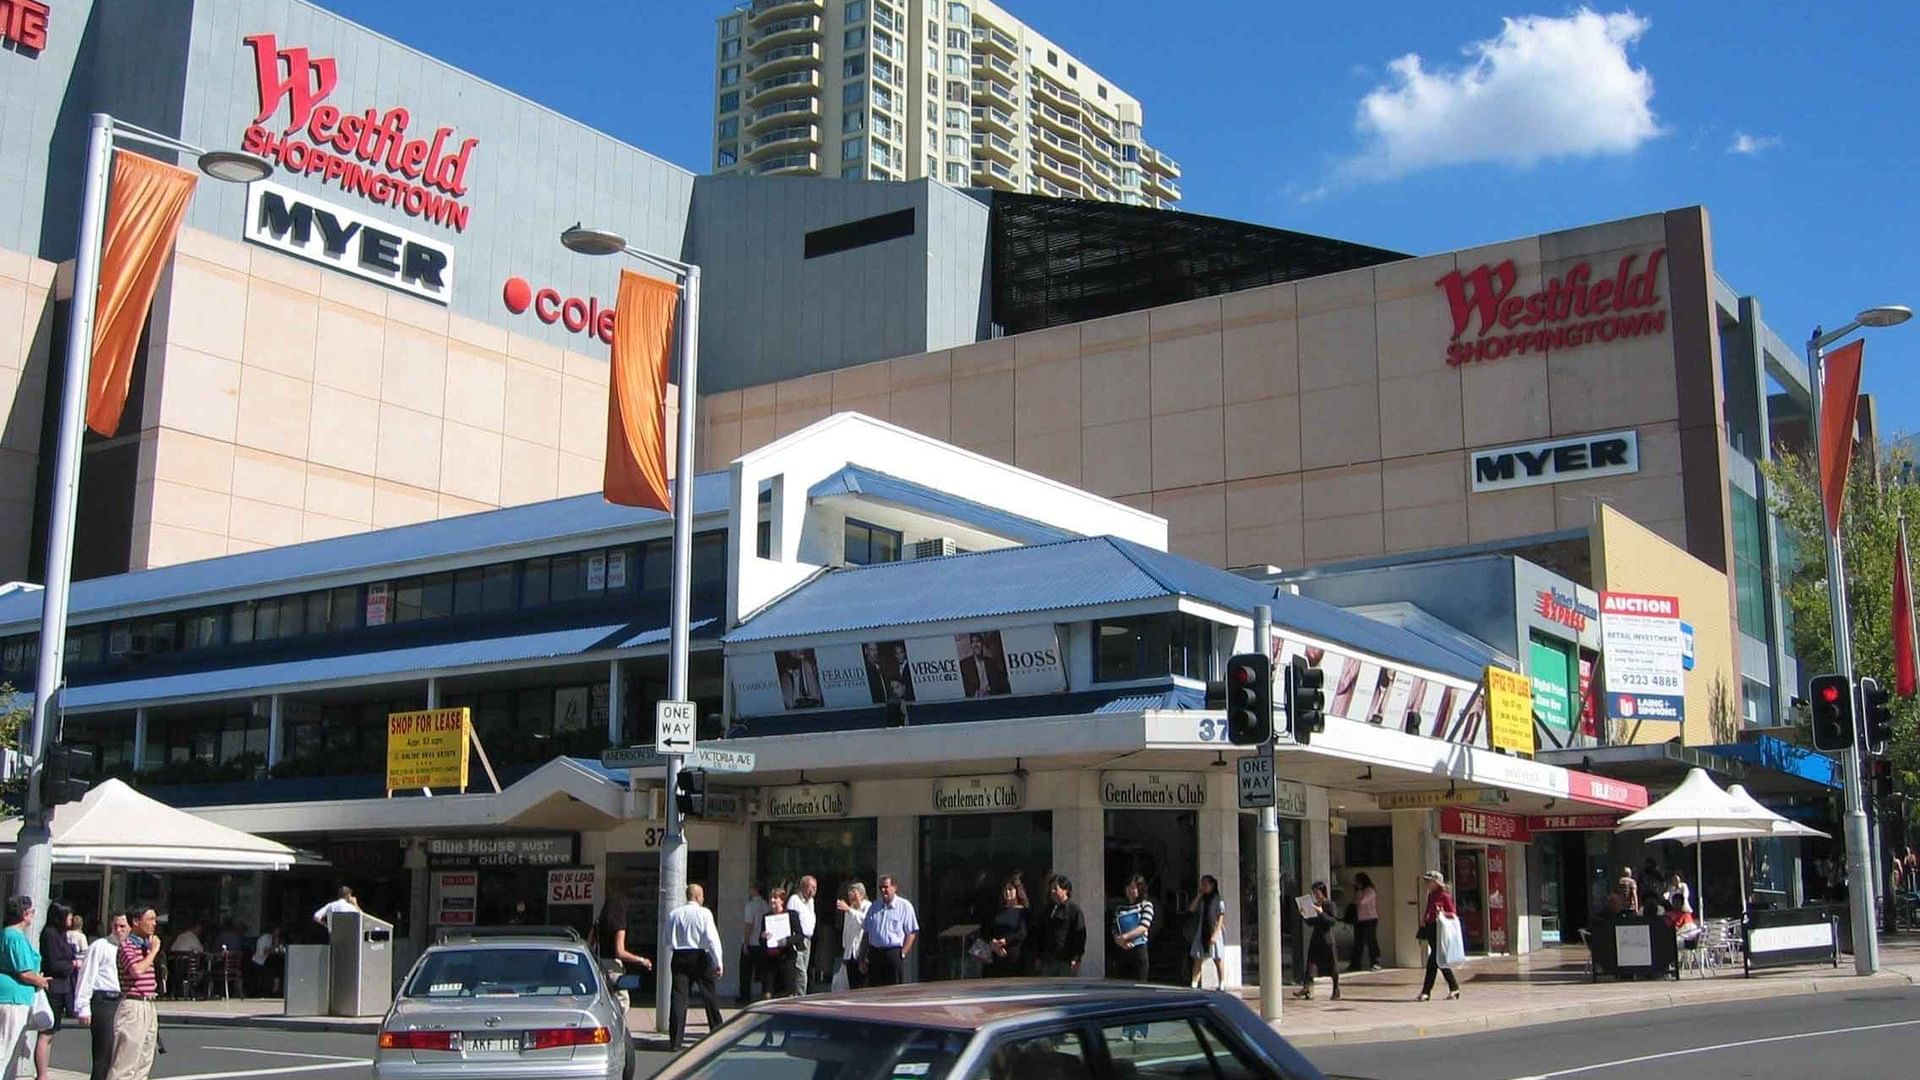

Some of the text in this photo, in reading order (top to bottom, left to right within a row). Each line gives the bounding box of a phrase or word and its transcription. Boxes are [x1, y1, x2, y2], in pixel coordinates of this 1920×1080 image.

[244, 34, 478, 196] Westfield
[243, 126, 470, 233] SHOPPINGTOWN
[260, 191, 448, 290] MYER
[1435, 248, 1666, 341] Westfield
[535, 288, 616, 345] cole
[1446, 310, 1665, 367] SHOPPINGTOWN
[1476, 438, 1630, 484] MYER
[1604, 595, 1672, 614] AUCTION
[911, 658, 958, 676] VERSACE
[1008, 649, 1057, 670] BOSS
[821, 667, 865, 682] FERAUD
[1622, 674, 1649, 686] 9223
[1651, 676, 1679, 687] 4888
[663, 706, 690, 719] ONE
[391, 711, 461, 735] SHOP FOR LEASE
[661, 723, 691, 735] WAY
[605, 751, 645, 762] ANDERSON
[699, 752, 752, 766] VICTORIA AVE
[1243, 760, 1269, 773] ONE
[1148, 774, 1160, 785] THE
[1241, 775, 1271, 788] WAY
[935, 785, 1017, 809] Gentlemen's Club
[1105, 783, 1205, 805] Gentlemen's Club
[769, 792, 843, 817] Gentlemen's Club
[432, 839, 464, 854] Blue
[468, 838, 516, 853] House
[479, 853, 524, 866] outlet
[528, 852, 571, 864] store
[553, 884, 592, 901] SALE
[563, 953, 575, 962] P
